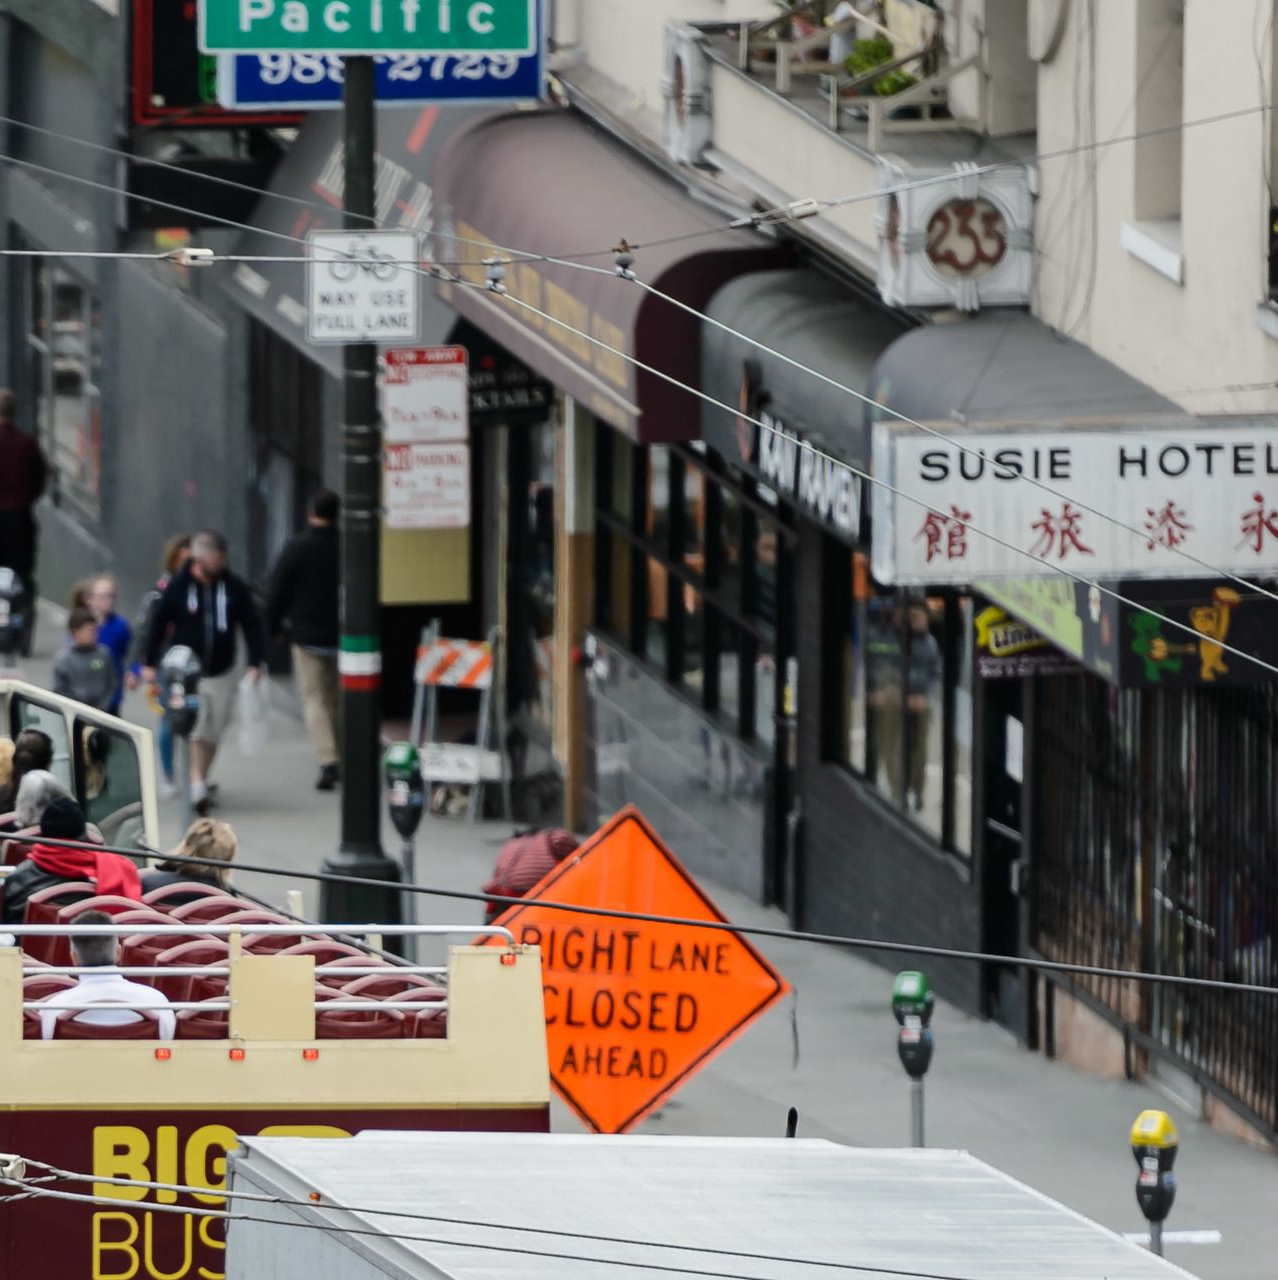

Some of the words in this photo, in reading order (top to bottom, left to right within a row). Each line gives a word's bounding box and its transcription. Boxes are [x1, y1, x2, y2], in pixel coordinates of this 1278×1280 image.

[321, 290, 359, 307] MAY
[370, 290, 408, 307] USE
[317, 313, 356, 328] FULL
[364, 312, 410, 329] LANE
[919, 448, 1072, 481] SUSIE
[1118, 444, 1278, 477] HOTEL
[522, 925, 640, 976] RIGHT
[651, 941, 731, 975] LANE
[544, 985, 699, 1033] CLOSED
[560, 1043, 668, 1080] AHEAD
[93, 1124, 240, 1205] BIG
